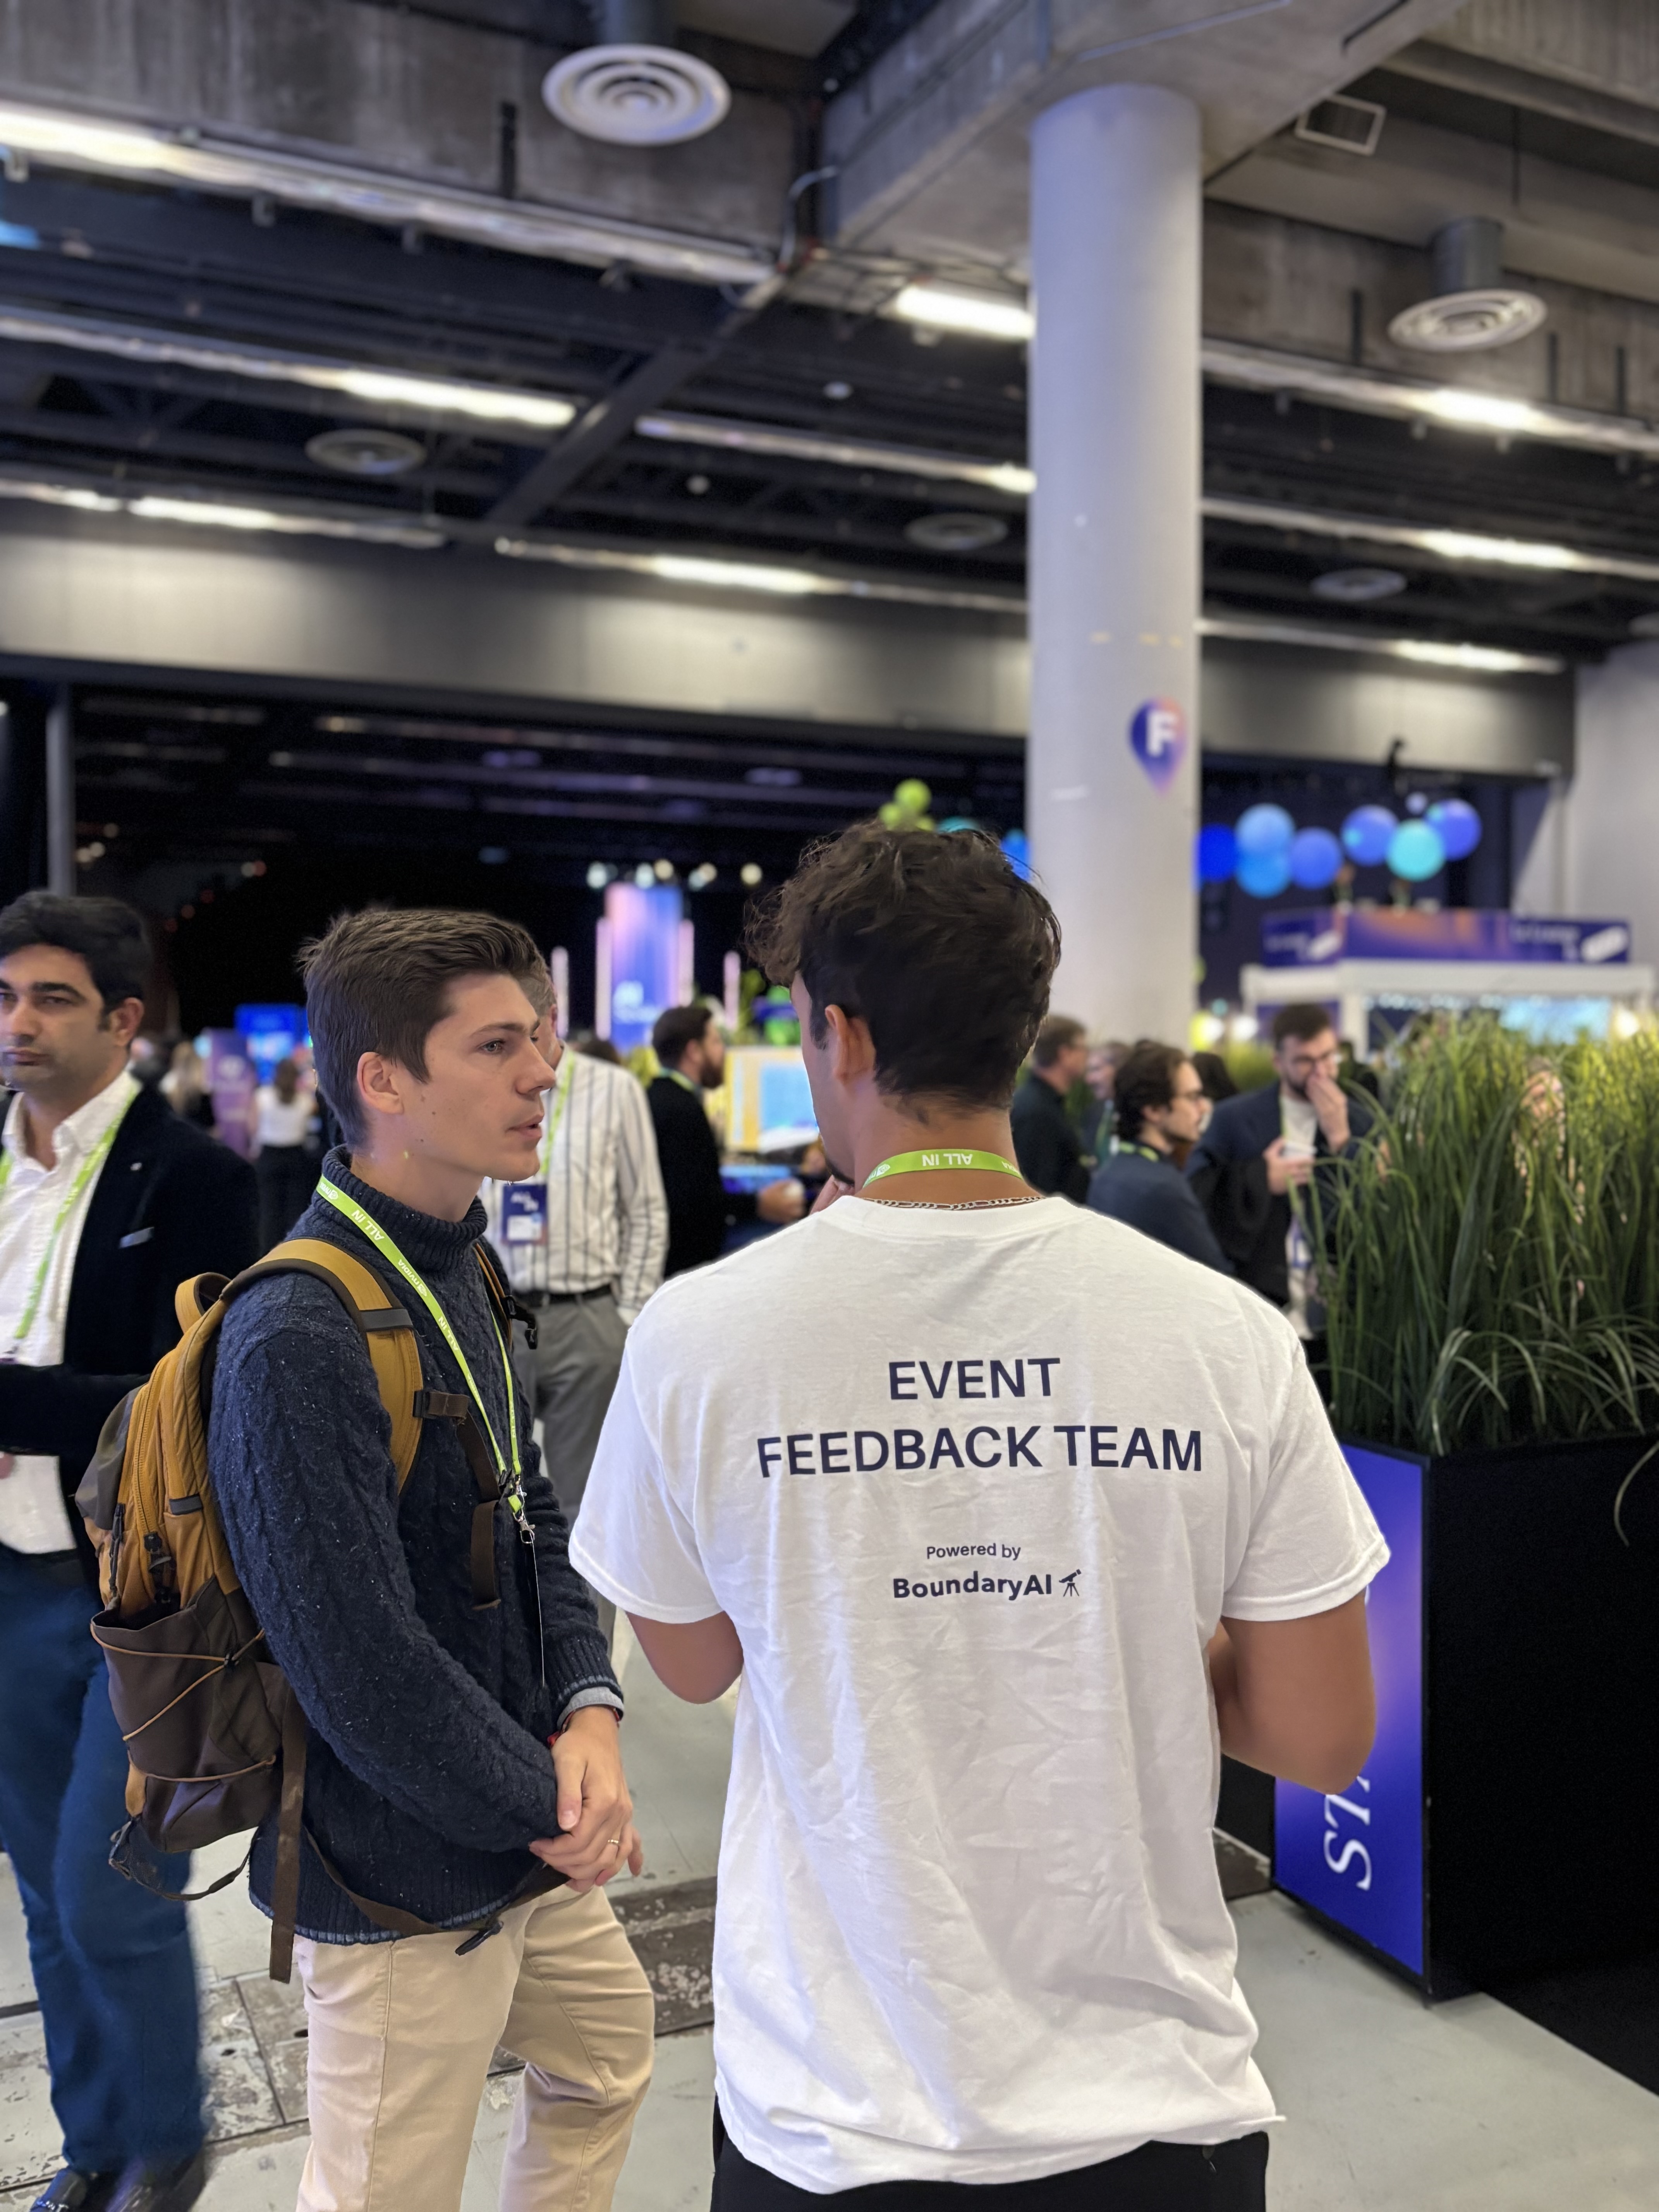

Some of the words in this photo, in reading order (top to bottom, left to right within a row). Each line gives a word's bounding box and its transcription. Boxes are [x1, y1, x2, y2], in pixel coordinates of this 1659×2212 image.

[1145, 710, 1179, 757] F
[922, 1154, 939, 1166] IN
[943, 1152, 973, 1166] ALL
[351, 1209, 366, 1223] IN
[364, 1220, 385, 1241] ALL
[438, 1316, 448, 1330] IN
[447, 1329, 459, 1351] ALL
[888, 1357, 1060, 1400] EVENT
[757, 1425, 1043, 1478] FEEDBACK
[1053, 1425, 1202, 1472] TEAM
[926, 1543, 997, 1559] Powered
[1001, 1544, 1021, 1561] by
[893, 1570, 1052, 1601] BoundaryAI
[1324, 1776, 1371, 1890] ST
